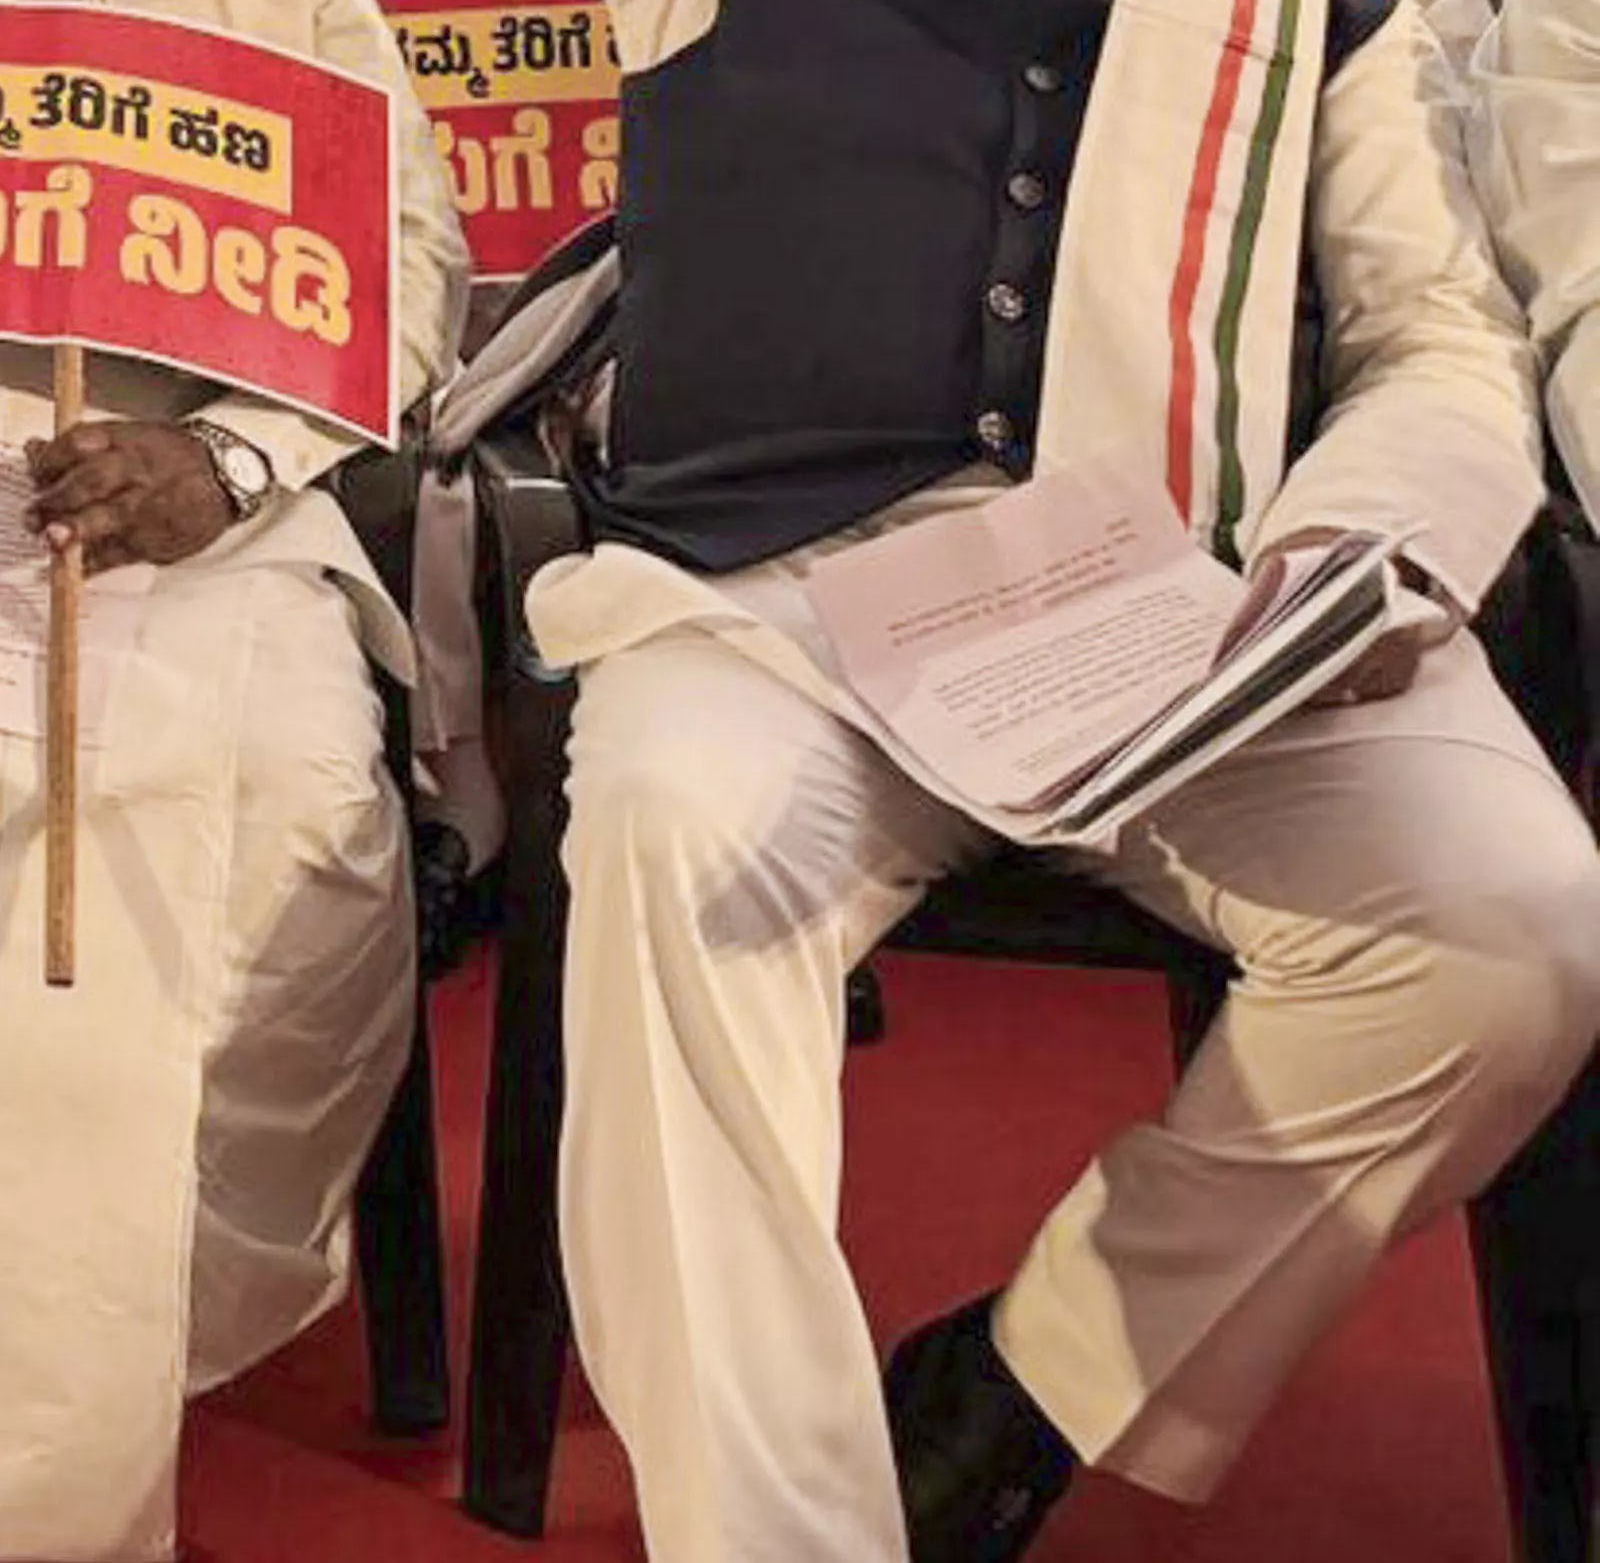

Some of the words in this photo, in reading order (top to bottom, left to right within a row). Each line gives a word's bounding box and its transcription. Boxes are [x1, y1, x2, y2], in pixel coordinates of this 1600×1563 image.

[492, 13, 592, 74] ತೆರಿಗೆ
[28, 74, 152, 140] ತೆರಿಗೆ
[169, 106, 271, 173] ಹಣ
[117, 193, 353, 348] ನೀಡಿ
